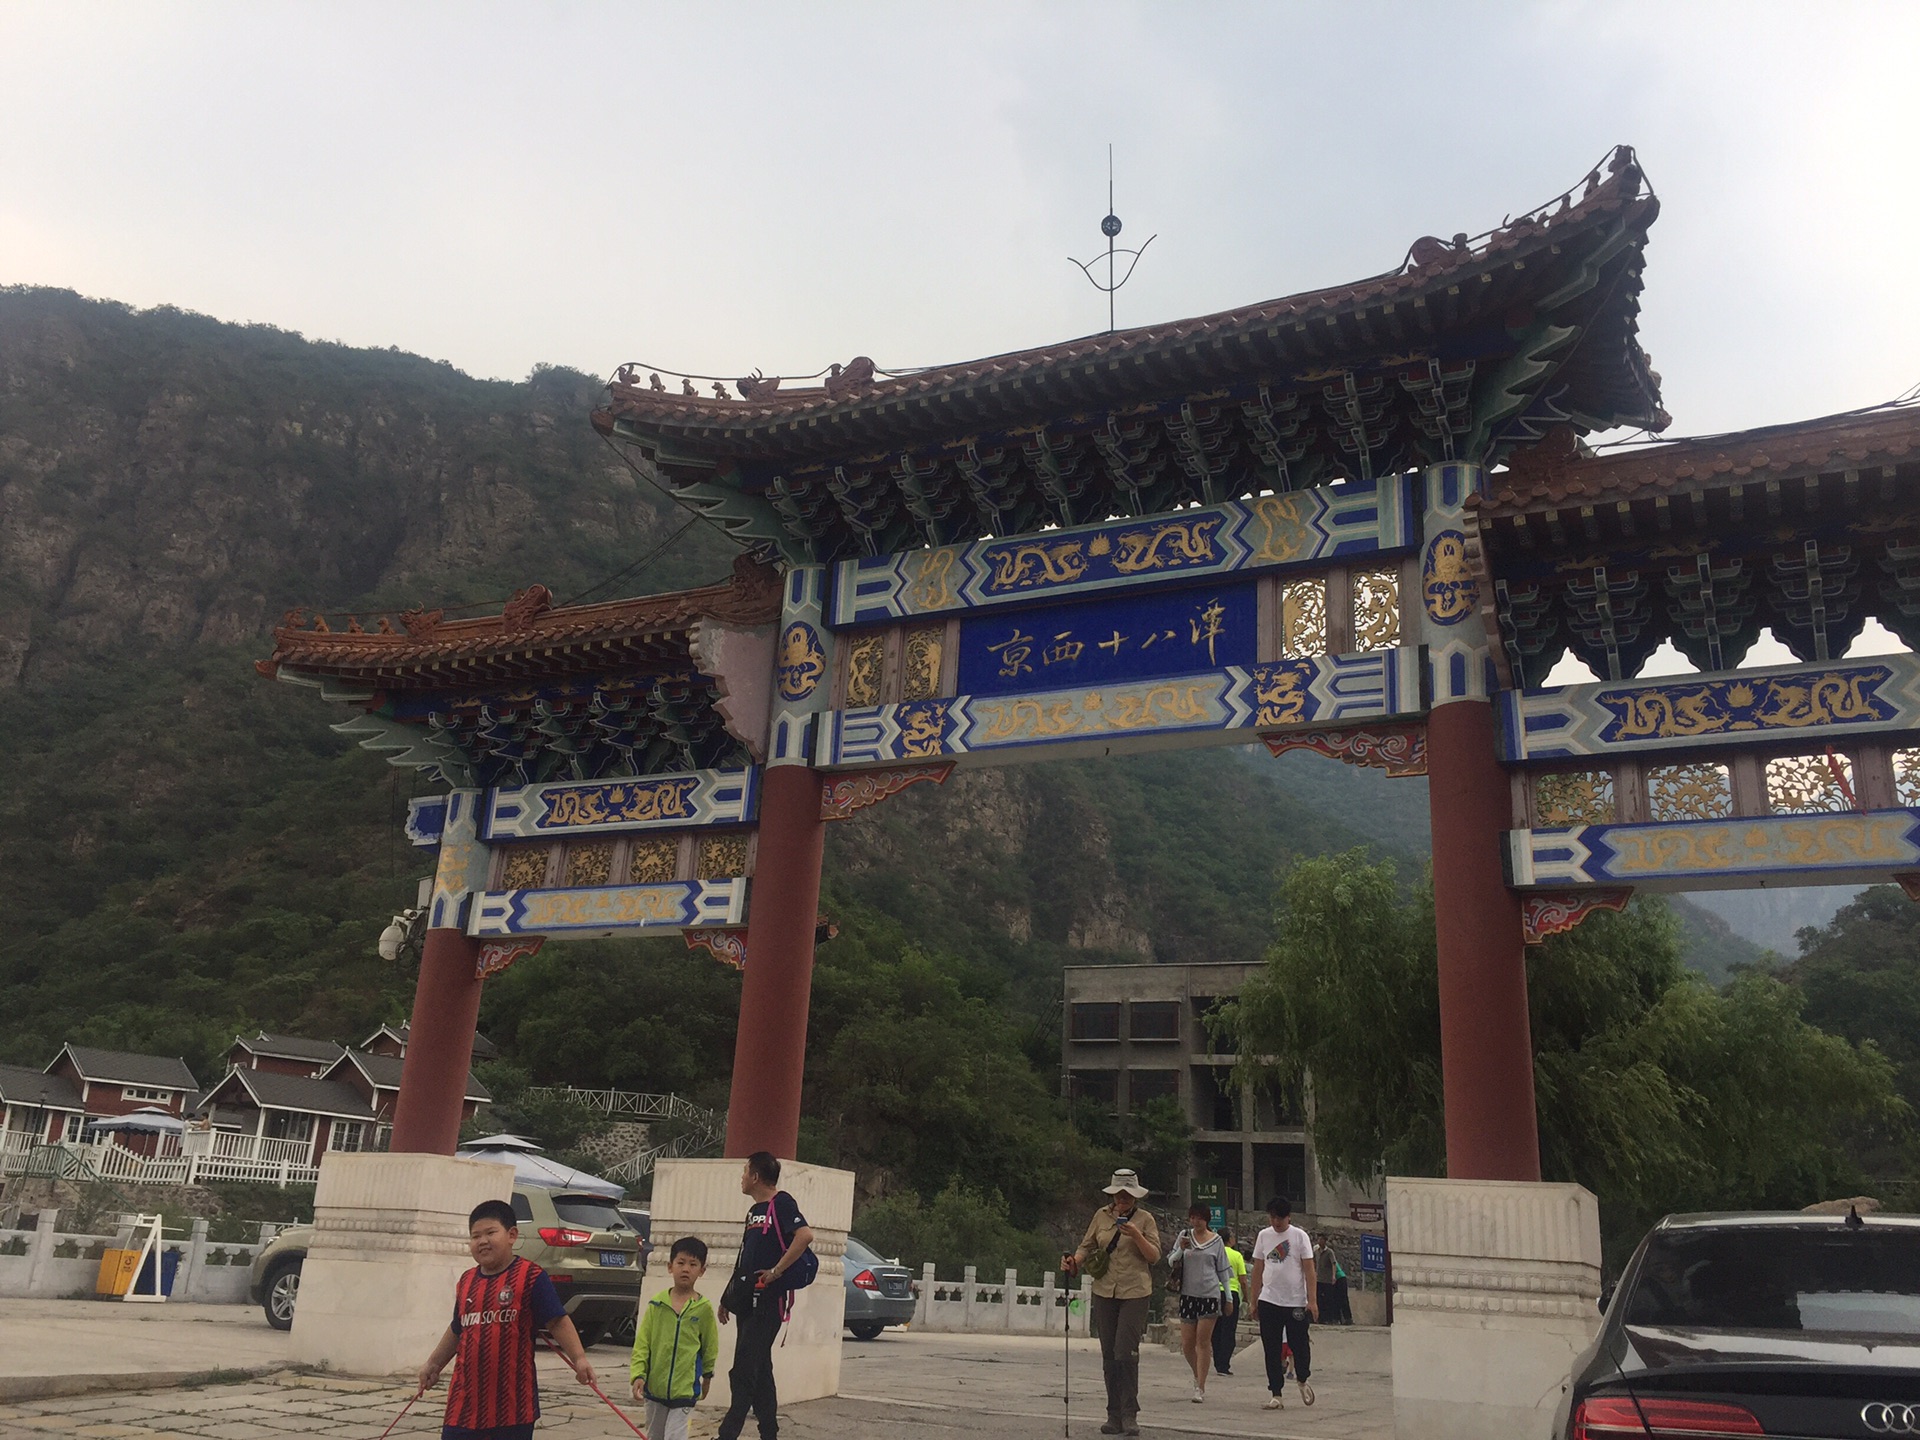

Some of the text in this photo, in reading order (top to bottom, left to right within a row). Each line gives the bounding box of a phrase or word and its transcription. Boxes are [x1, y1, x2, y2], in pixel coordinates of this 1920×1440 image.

[987, 597, 1226, 677] 京西十八潭
[481, 1309, 518, 1325] SOCCER
